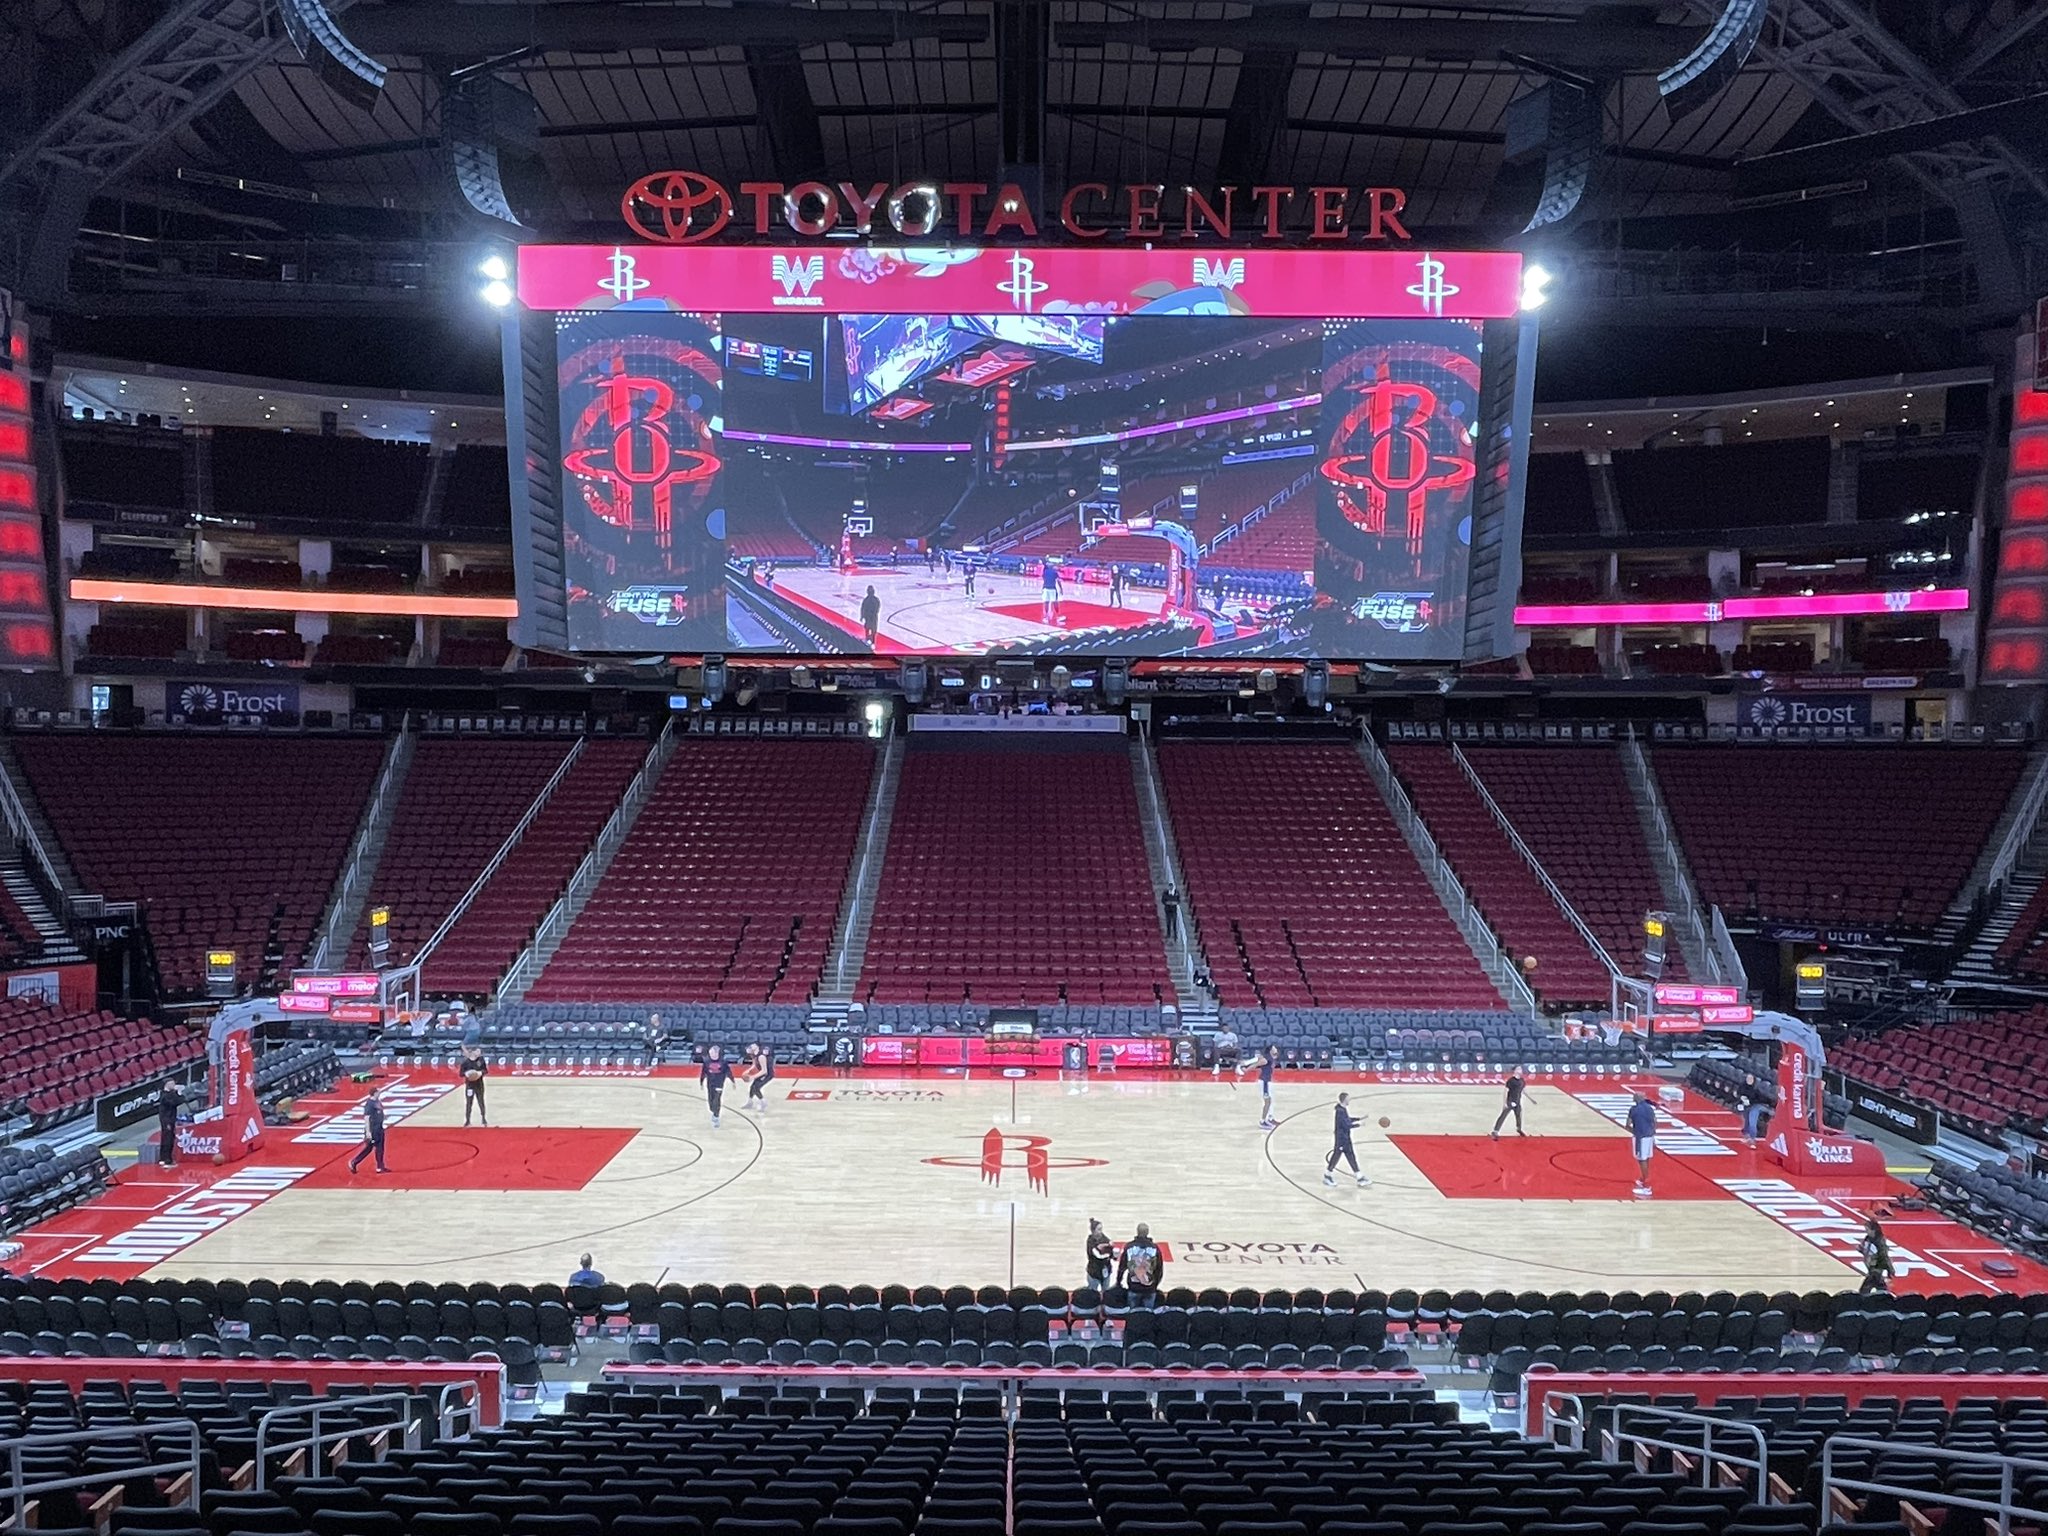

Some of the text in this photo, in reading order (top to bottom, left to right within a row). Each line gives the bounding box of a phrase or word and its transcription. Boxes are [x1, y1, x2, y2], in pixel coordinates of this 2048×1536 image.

[740, 182, 1412, 240] TOYOTA CENTER
[614, 597, 672, 613] FUSE
[1358, 604, 1417, 620] FUSE
[222, 692, 287, 714] Frost
[1790, 701, 1856, 724] Frost
[95, 925, 130, 940] PNC
[228, 1038, 241, 1105] credit karma
[1793, 1052, 1804, 1119] credit karma
[179, 1135, 222, 1147] DRAFT
[182, 1145, 220, 1155] KINGS
[1811, 1145, 1853, 1156] DRAFT
[1815, 1154, 1854, 1164] KINGS
[72, 1166, 316, 1263] HOUSTON
[1177, 1241, 1338, 1254] TOYOTA
[1183, 1253, 1347, 1266] CENTER
